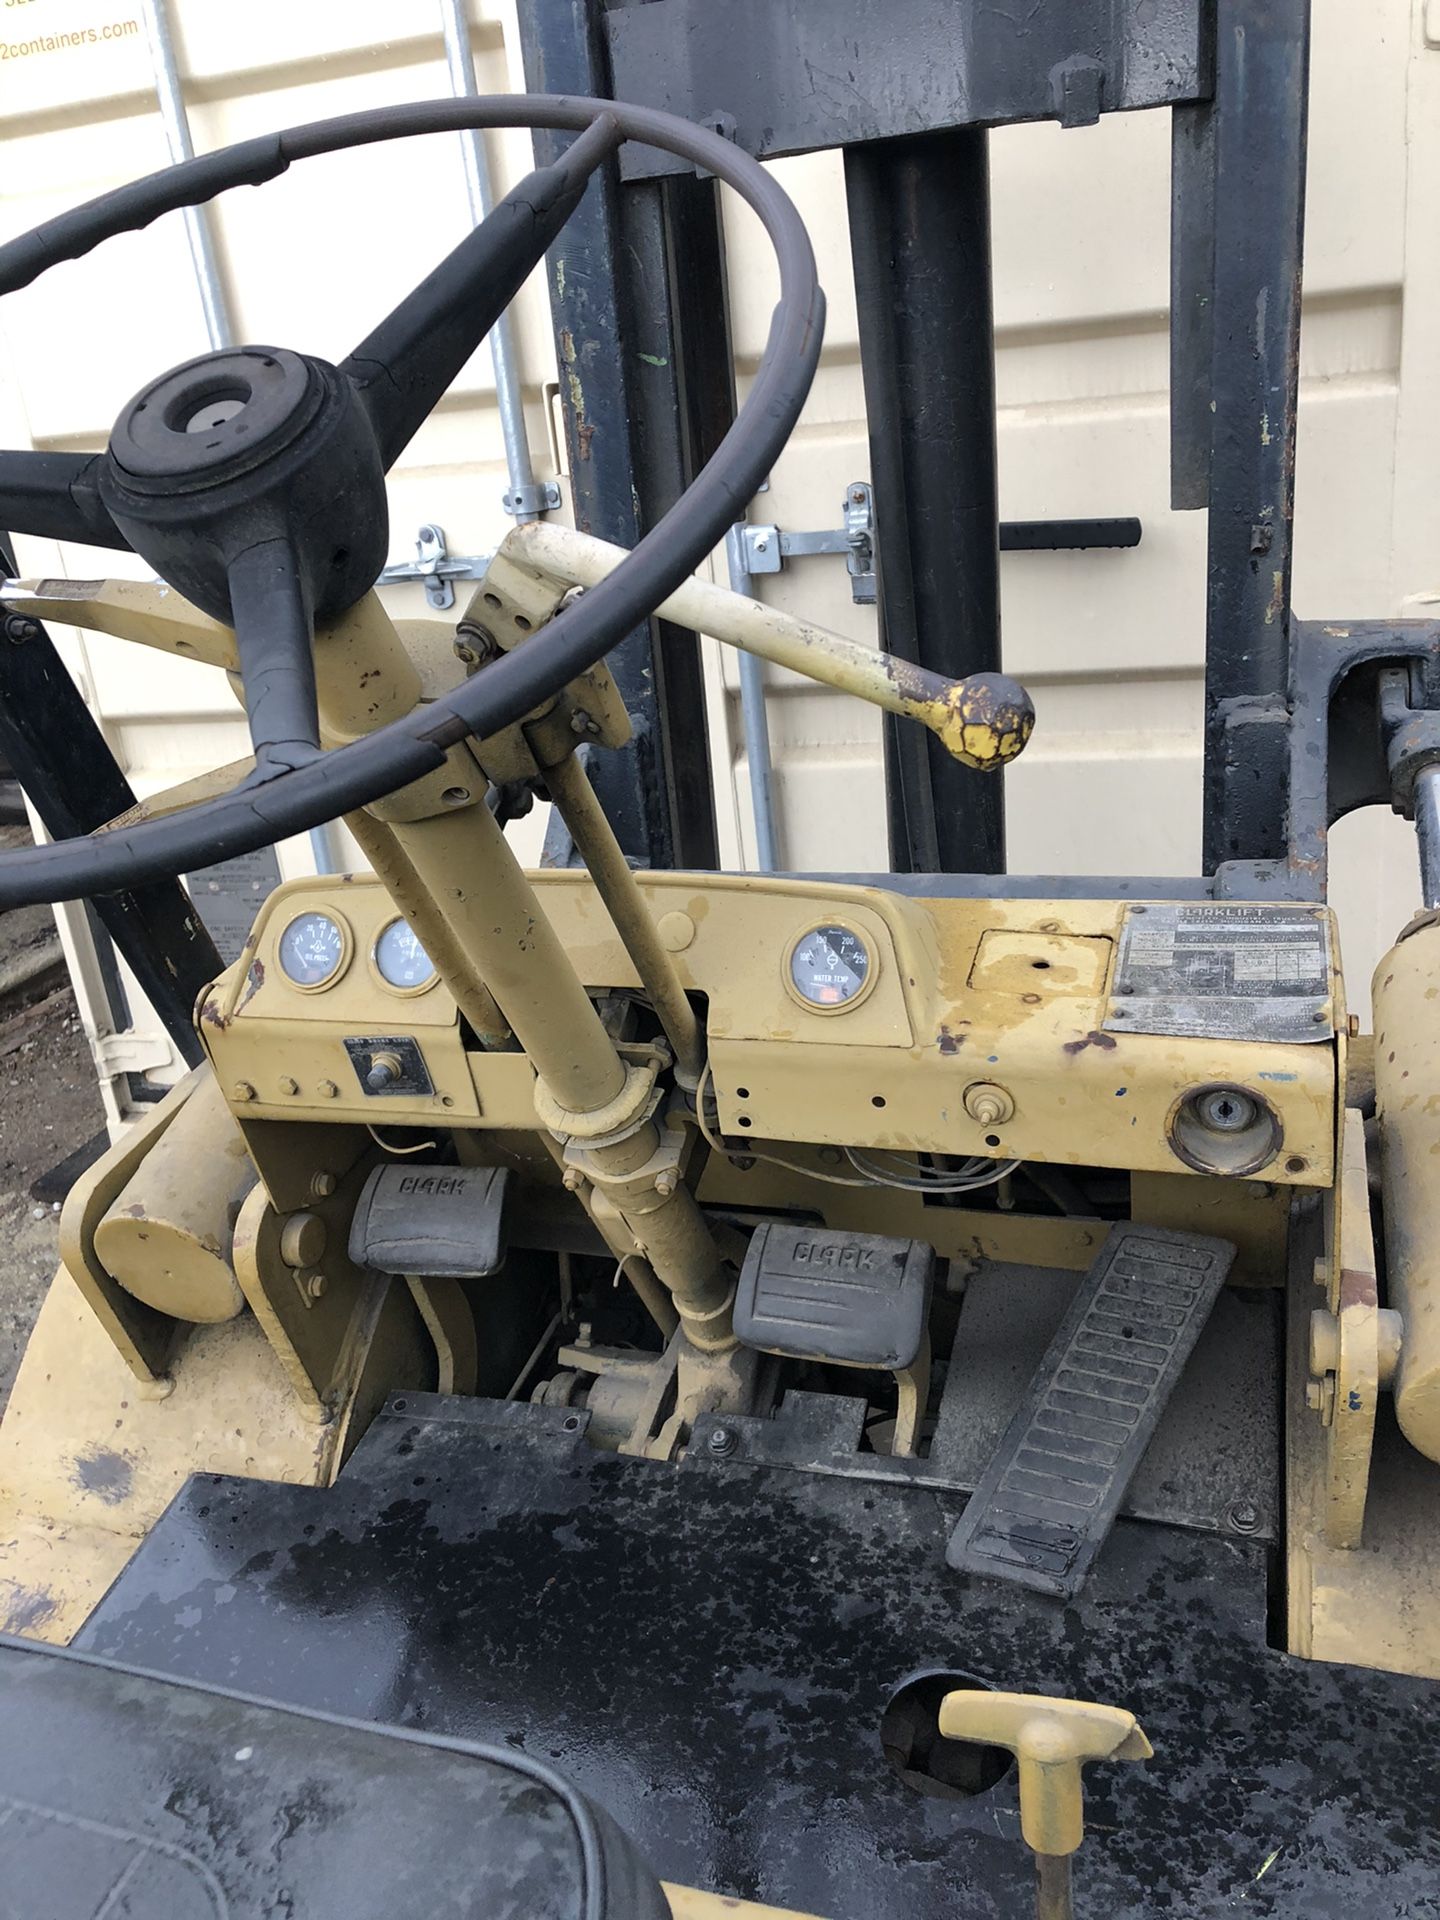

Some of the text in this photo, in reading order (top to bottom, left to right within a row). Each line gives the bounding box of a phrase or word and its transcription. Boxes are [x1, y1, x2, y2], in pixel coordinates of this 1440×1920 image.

[1175, 908, 1266, 917] CLARKLIFT
[816, 936, 827, 944] 150
[841, 937, 854, 945] 200
[814, 974, 849, 983] WATER TEMP
[398, 1176, 468, 1196] CLARK
[792, 1242, 875, 1269] CLARK
